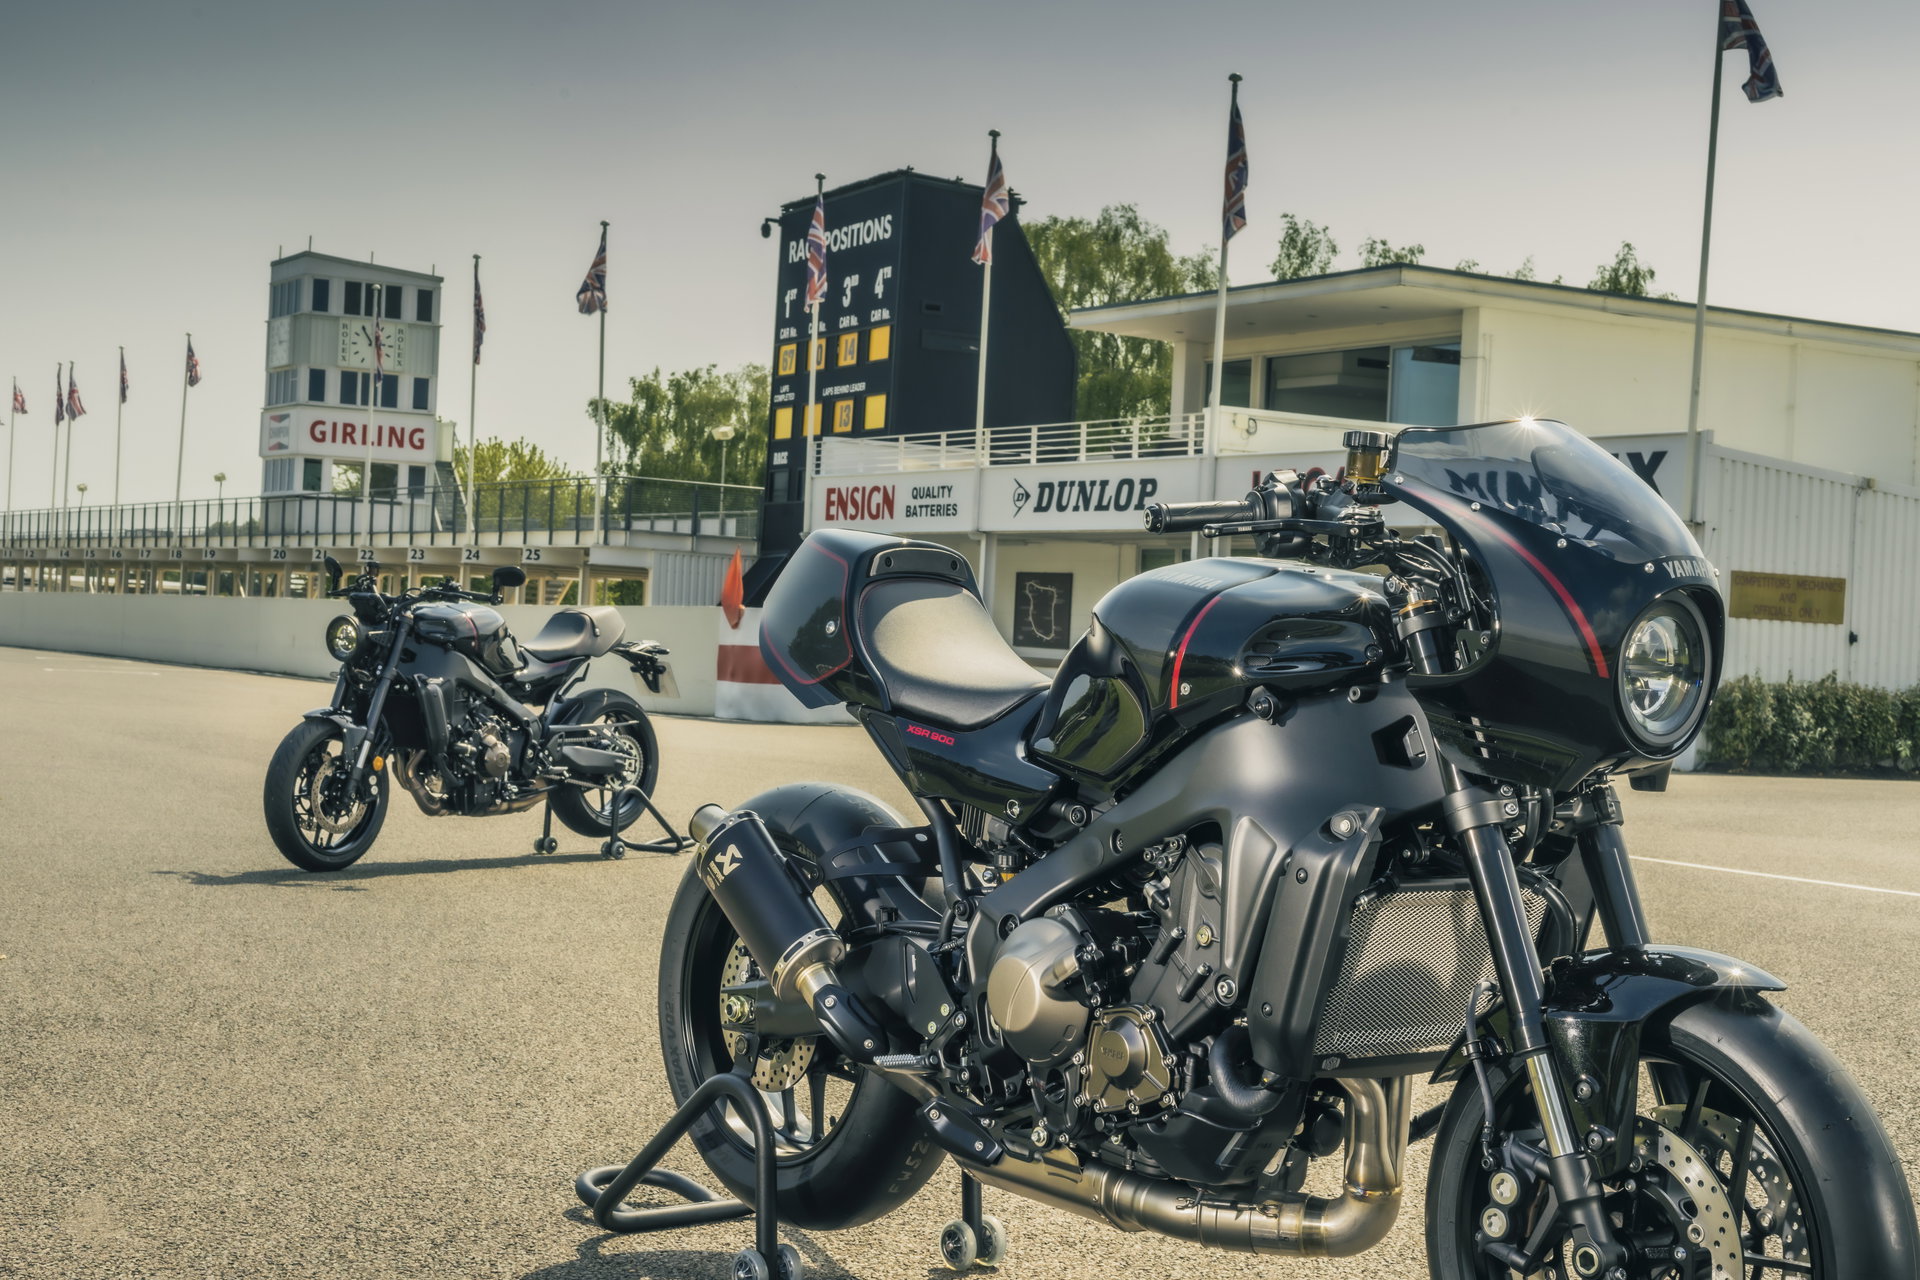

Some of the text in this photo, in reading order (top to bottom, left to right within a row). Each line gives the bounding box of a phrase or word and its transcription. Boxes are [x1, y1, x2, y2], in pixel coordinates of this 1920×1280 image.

[823, 214, 892, 252] POSITIONS
[341, 323, 349, 362] ROLEX
[396, 328, 404, 367] ROLEX
[843, 338, 855, 362] 14
[309, 419, 425, 450] GIRLING
[911, 485, 953, 500] QUALITY
[1033, 478, 1158, 513] DUNLOP
[825, 485, 895, 521] ENSIGN
[905, 503, 958, 518] BATTERIES
[25, 550, 34, 558] 12
[60, 550, 70, 558] 14
[85, 550, 95, 558] 15
[111, 550, 122, 558] 16
[140, 550, 152, 558] 17
[171, 550, 182, 559] 18
[204, 550, 216, 559] 19
[273, 549, 287, 560] 20
[315, 549, 327, 559] 21
[360, 549, 374, 560] 22
[410, 549, 425, 560] 23
[465, 549, 480, 561] 24
[525, 549, 541, 561] 25
[1662, 559, 1709, 579] YAMAH
[1734, 575, 1843, 593] COMPETITORS MECHANICS
[1779, 592, 1797, 603] AND
[1753, 604, 1822, 619] OFFICIALS ONLY
[907, 725, 955, 746] XSR 900
